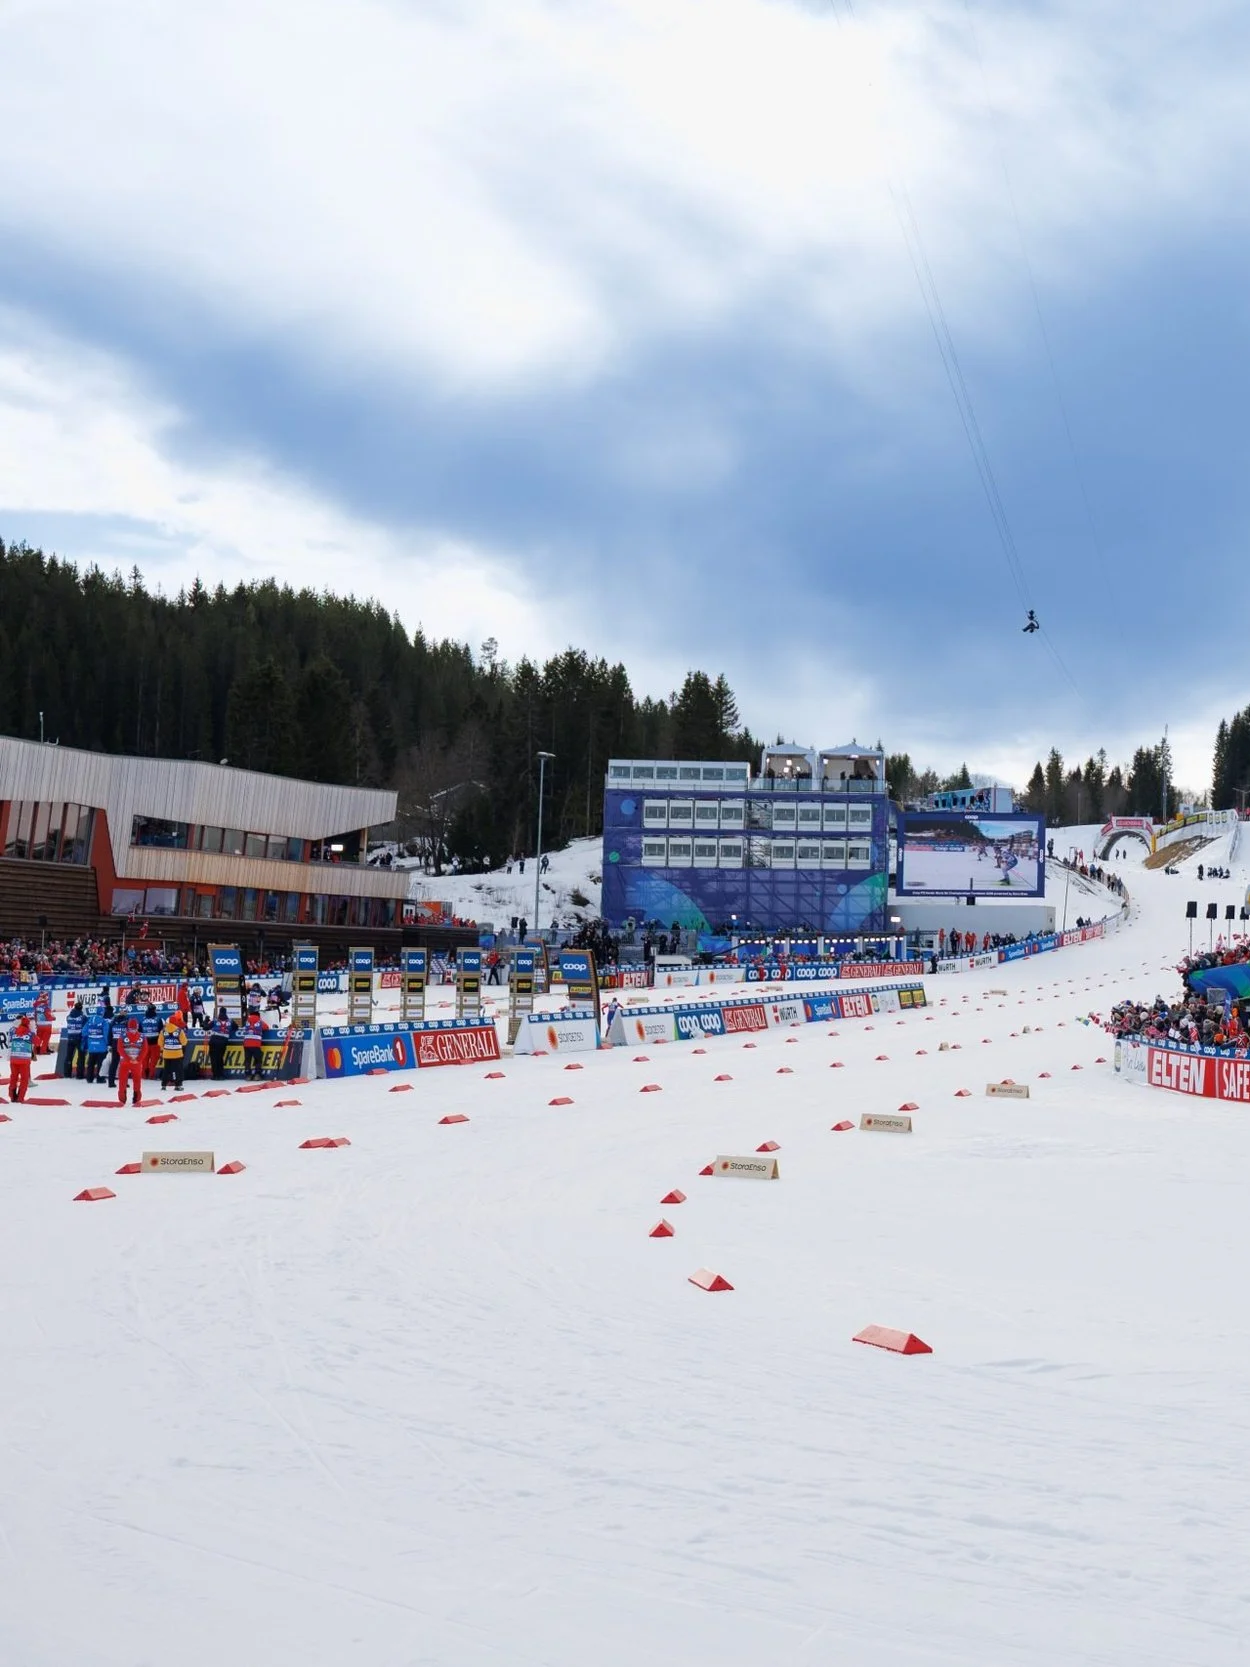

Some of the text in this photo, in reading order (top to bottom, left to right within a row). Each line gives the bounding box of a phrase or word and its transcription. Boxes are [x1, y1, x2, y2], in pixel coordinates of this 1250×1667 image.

[215, 958, 239, 967] coop
[563, 963, 587, 971] coop
[748, 968, 768, 980] cop
[796, 967, 838, 979] coop coop
[318, 978, 337, 990] coop
[678, 1013, 721, 1033] coop coop
[733, 1007, 767, 1029] GENERALI
[436, 1031, 497, 1061] GENERALI
[351, 1040, 403, 1069] SpareBank 1
[1151, 1050, 1206, 1094] ELTEN
